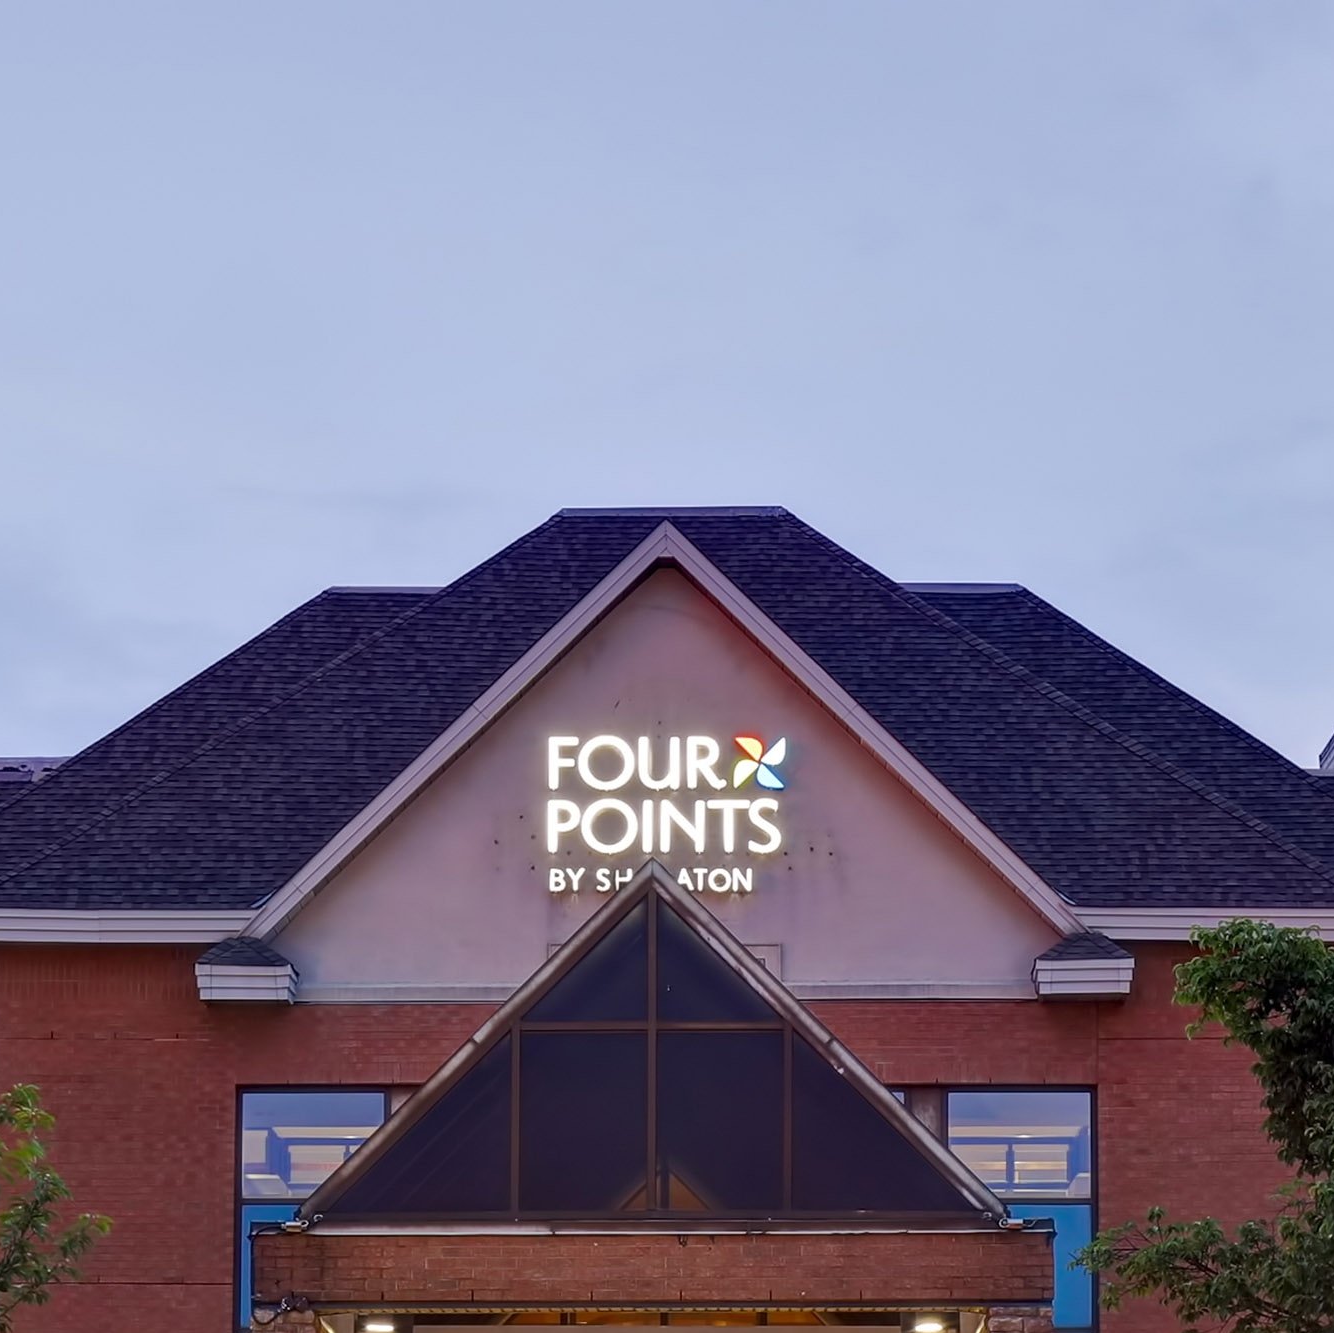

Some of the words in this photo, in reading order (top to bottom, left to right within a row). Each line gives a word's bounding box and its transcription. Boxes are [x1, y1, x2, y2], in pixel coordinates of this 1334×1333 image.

[548, 735, 727, 791] FOUR
[547, 797, 782, 853] POINTS
[548, 867, 586, 892] BY
[595, 867, 753, 892] SHATON
